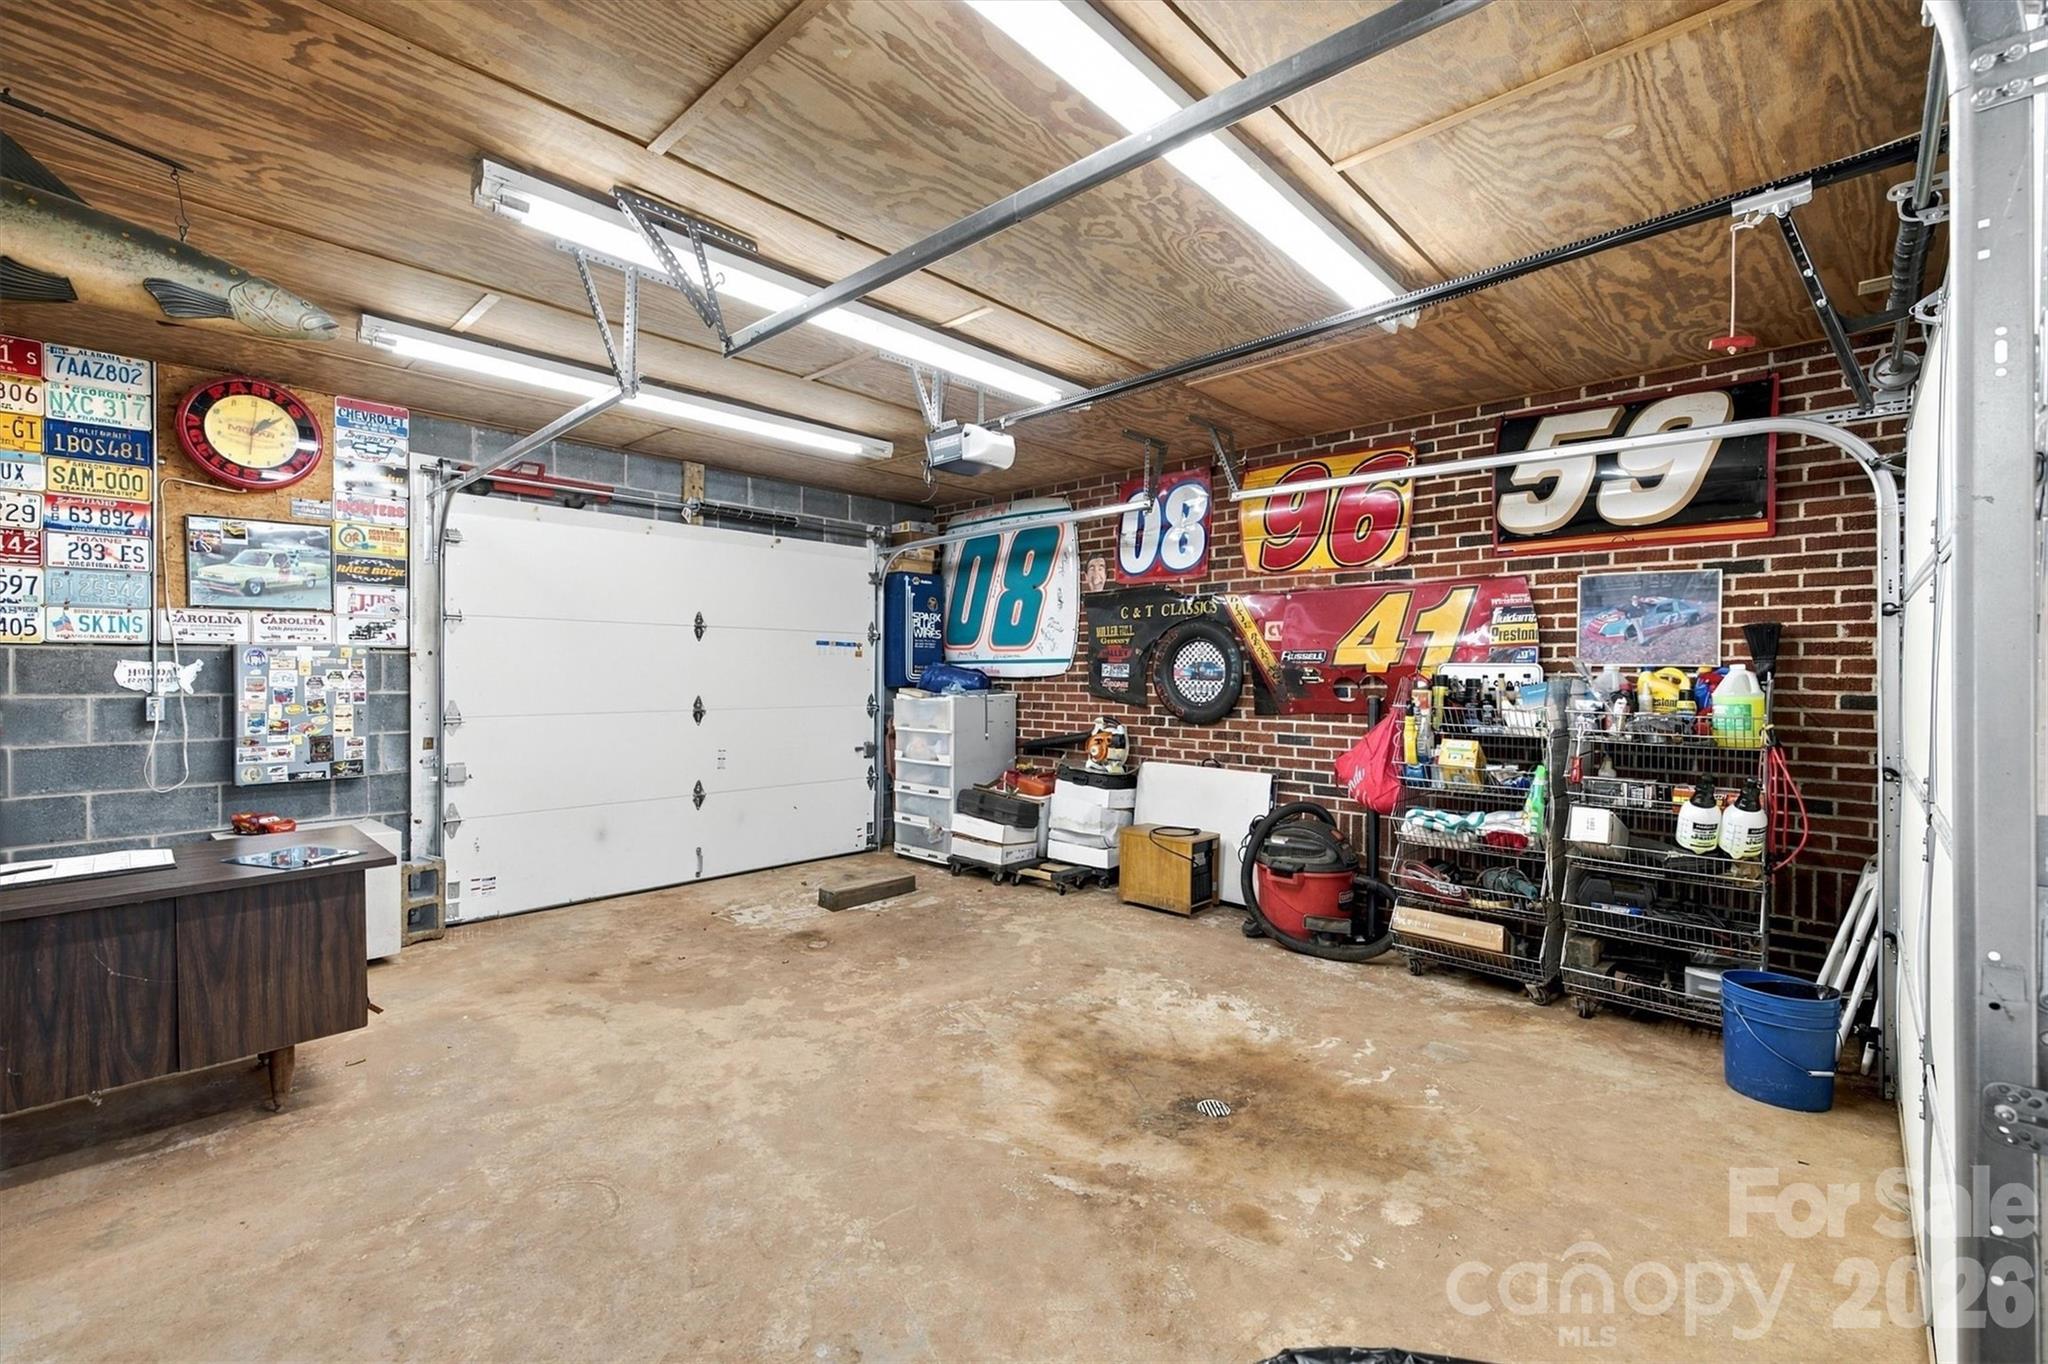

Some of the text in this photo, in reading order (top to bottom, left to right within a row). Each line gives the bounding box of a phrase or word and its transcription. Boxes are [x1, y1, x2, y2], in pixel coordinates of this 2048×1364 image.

[53, 355, 144, 386] 7AAZ802
[72, 386, 127, 401] GEORGIA
[49, 391, 146, 421] NXC 317
[338, 408, 405, 428] CHEVROLET
[54, 434, 145, 461] 1BQS481
[1497, 390, 1735, 535] 59
[53, 466, 144, 492] SAM-000
[1260, 450, 1415, 572] 96
[1118, 482, 1210, 575] 08
[77, 535, 122, 545] MAINE
[68, 541, 145, 564] 293 ES
[337, 564, 406, 577] RACE ROCK
[946, 524, 1063, 648] 08
[912, 611, 941, 621] SPARK
[1120, 600, 1218, 620] C & T CLASSICS
[78, 614, 144, 634] SKINS
[260, 615, 325, 627] CAROLINA
[913, 619, 936, 629] PLUG
[1331, 584, 1481, 675] 41
[913, 627, 942, 639] WIRES
